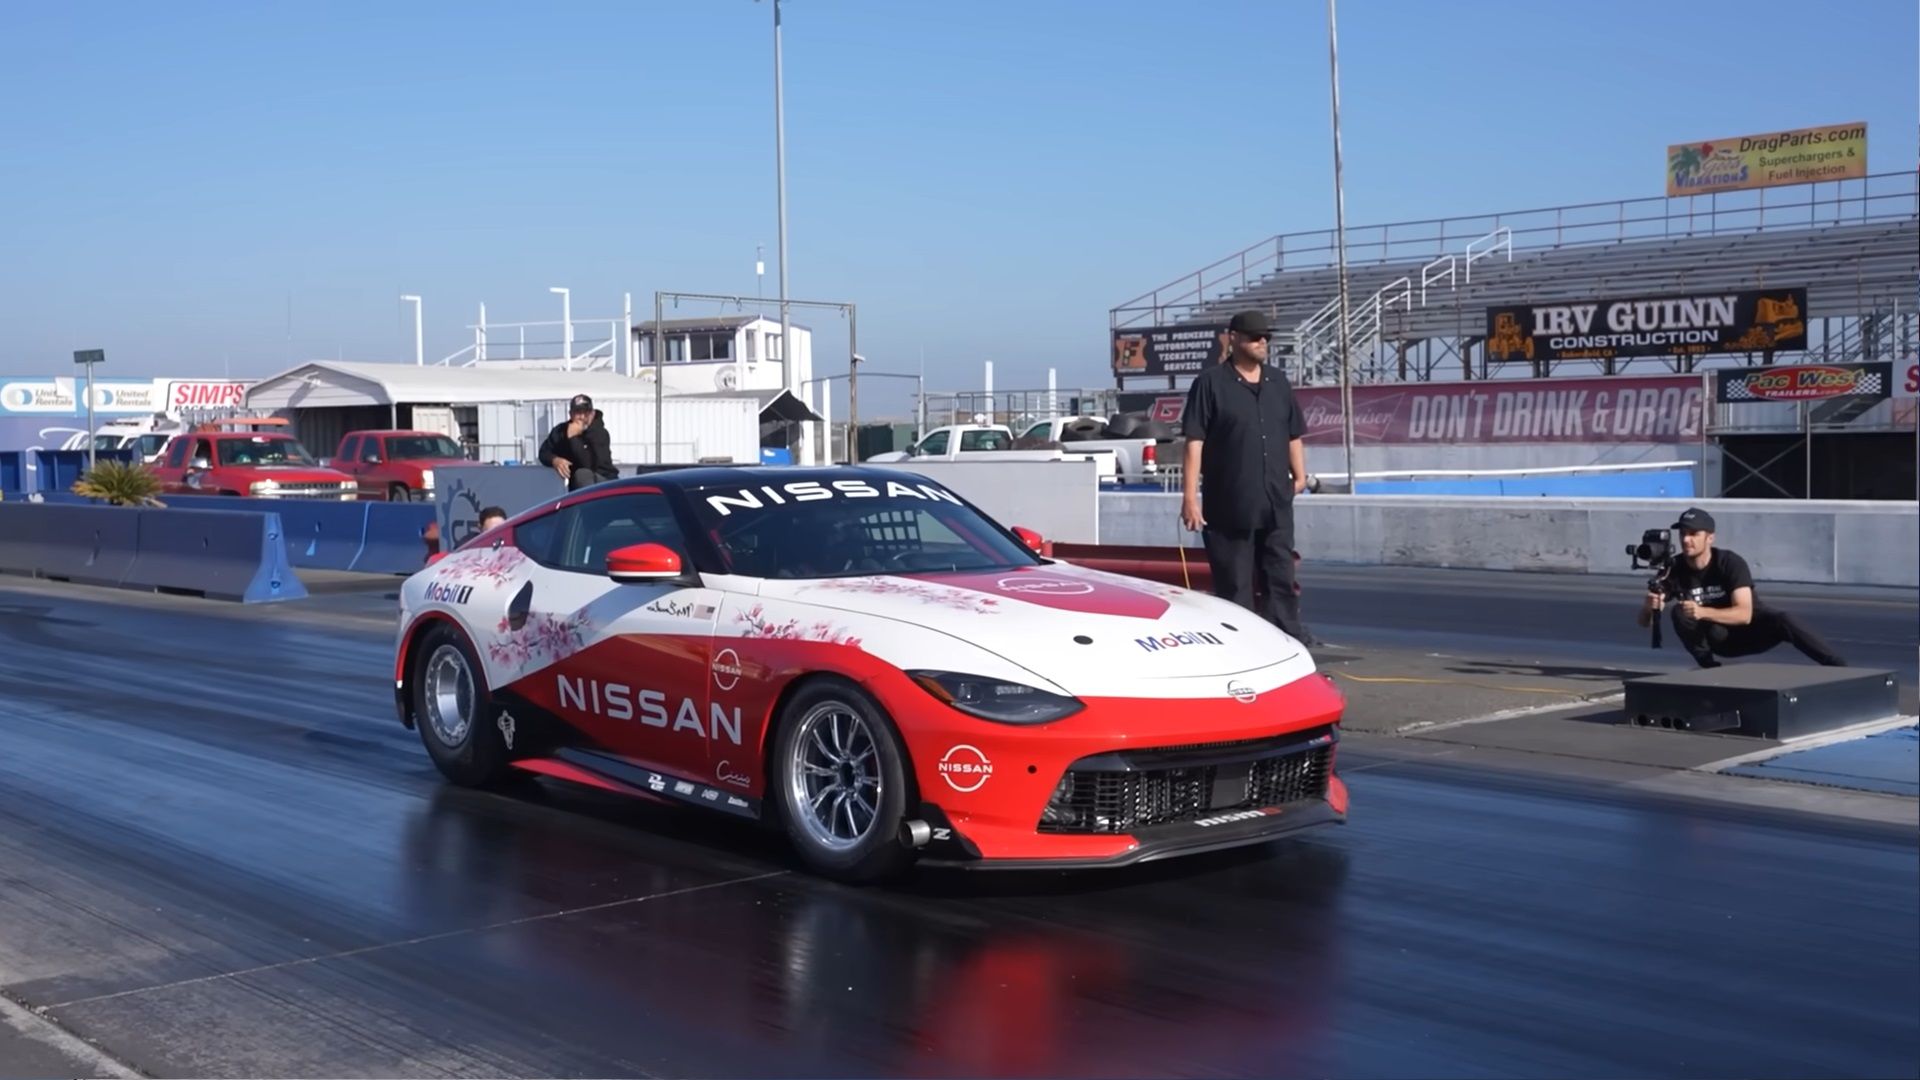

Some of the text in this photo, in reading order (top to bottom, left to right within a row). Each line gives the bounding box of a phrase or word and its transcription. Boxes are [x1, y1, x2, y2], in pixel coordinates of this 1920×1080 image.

[1739, 126, 1865, 153] DragParts.com
[1759, 146, 1855, 168] Superchargers &
[1768, 163, 1846, 181] Fuel Injection
[1532, 296, 1738, 335] IRV GUINN
[1152, 334, 1168, 342] THE
[1172, 331, 1215, 341] PREMIERE
[1154, 341, 1212, 352] MOTORSPORTS
[1550, 329, 1719, 350] CONSTRUCTION
[1159, 351, 1208, 361] TICKETING
[1164, 362, 1202, 371] SERVICE
[1745, 367, 1865, 389] Pac West
[35, 397, 73, 406] Rentals
[115, 390, 150, 400] United
[175, 383, 245, 405] SIMPS
[1304, 404, 1394, 429] Budeiser
[1408, 387, 1702, 439] DON'T DRINK & DRAG
[706, 480, 964, 516] NISSAN
[424, 581, 461, 603] Mobil
[1134, 632, 1205, 652] Mobil
[712, 663, 742, 676] NISSAN
[557, 674, 742, 745] NISSAN
[938, 762, 993, 774] NISSAN
